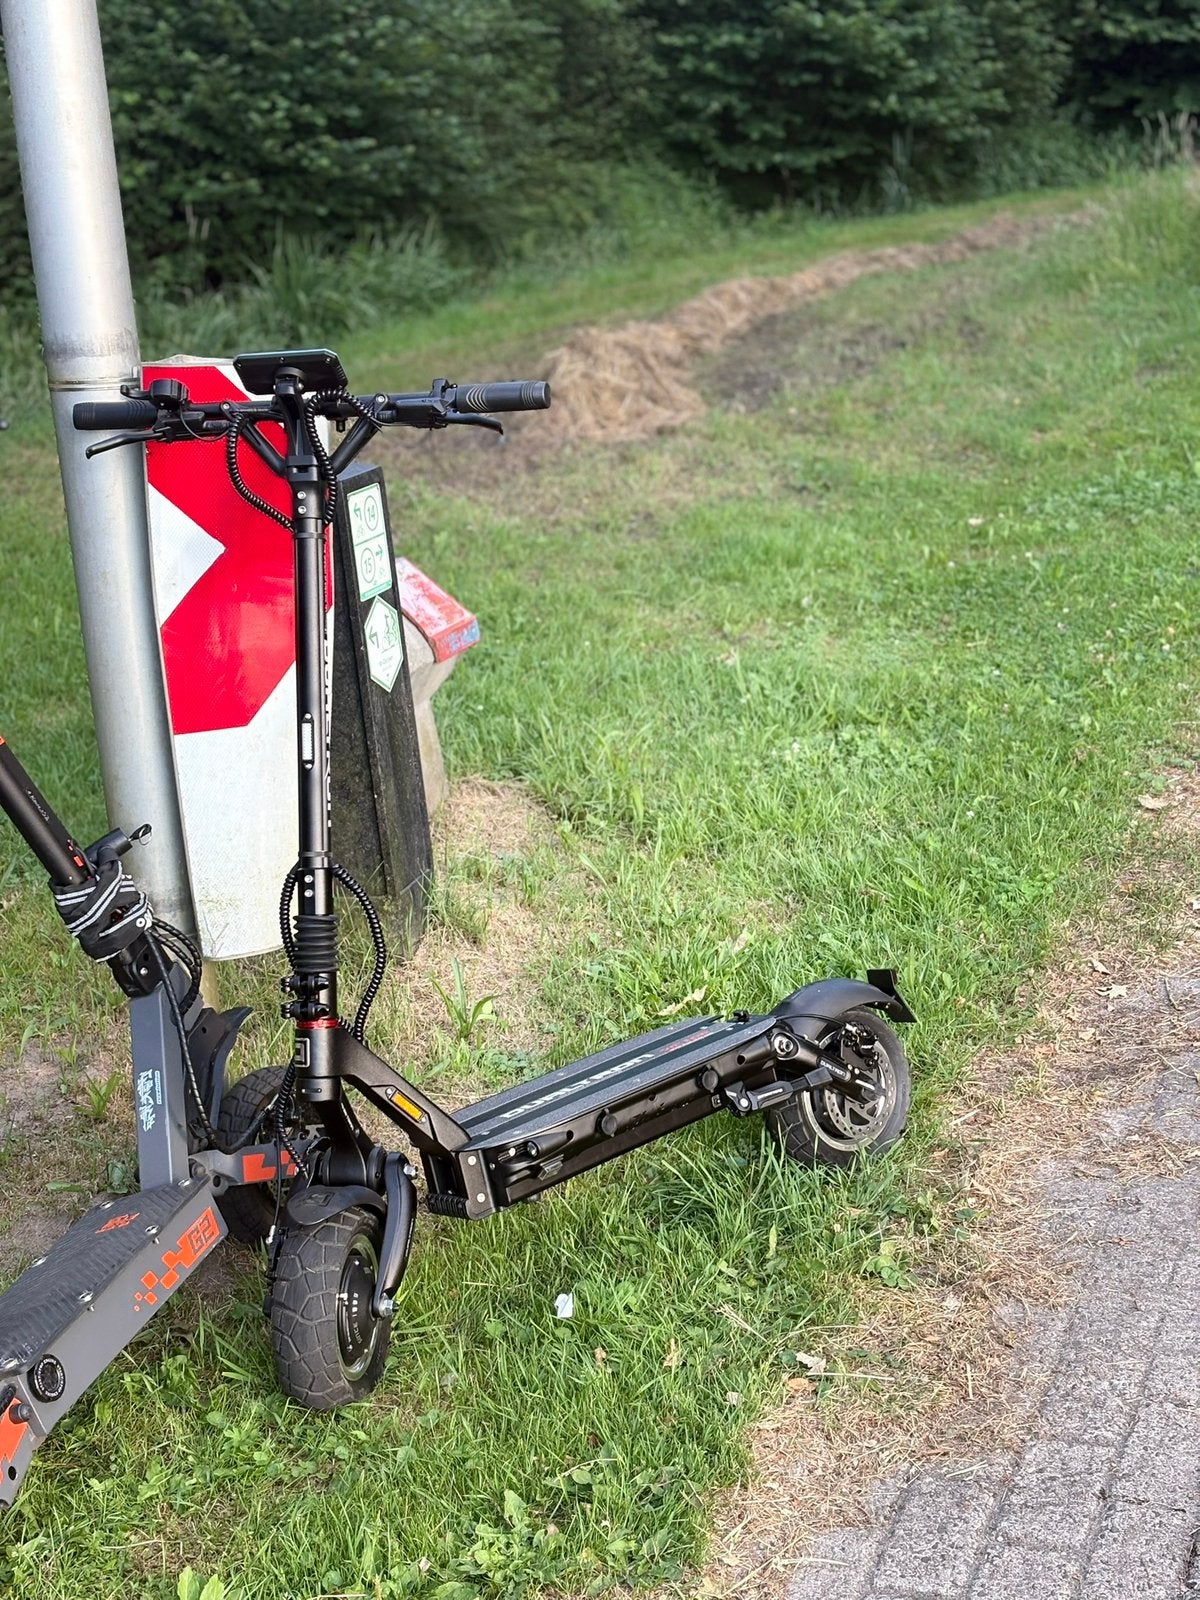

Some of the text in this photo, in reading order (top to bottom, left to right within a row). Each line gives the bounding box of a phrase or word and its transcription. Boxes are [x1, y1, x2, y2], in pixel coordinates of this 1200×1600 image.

[367, 504, 376, 522] 14
[364, 557, 373, 575] 15
[188, 1214, 214, 1255] G2
